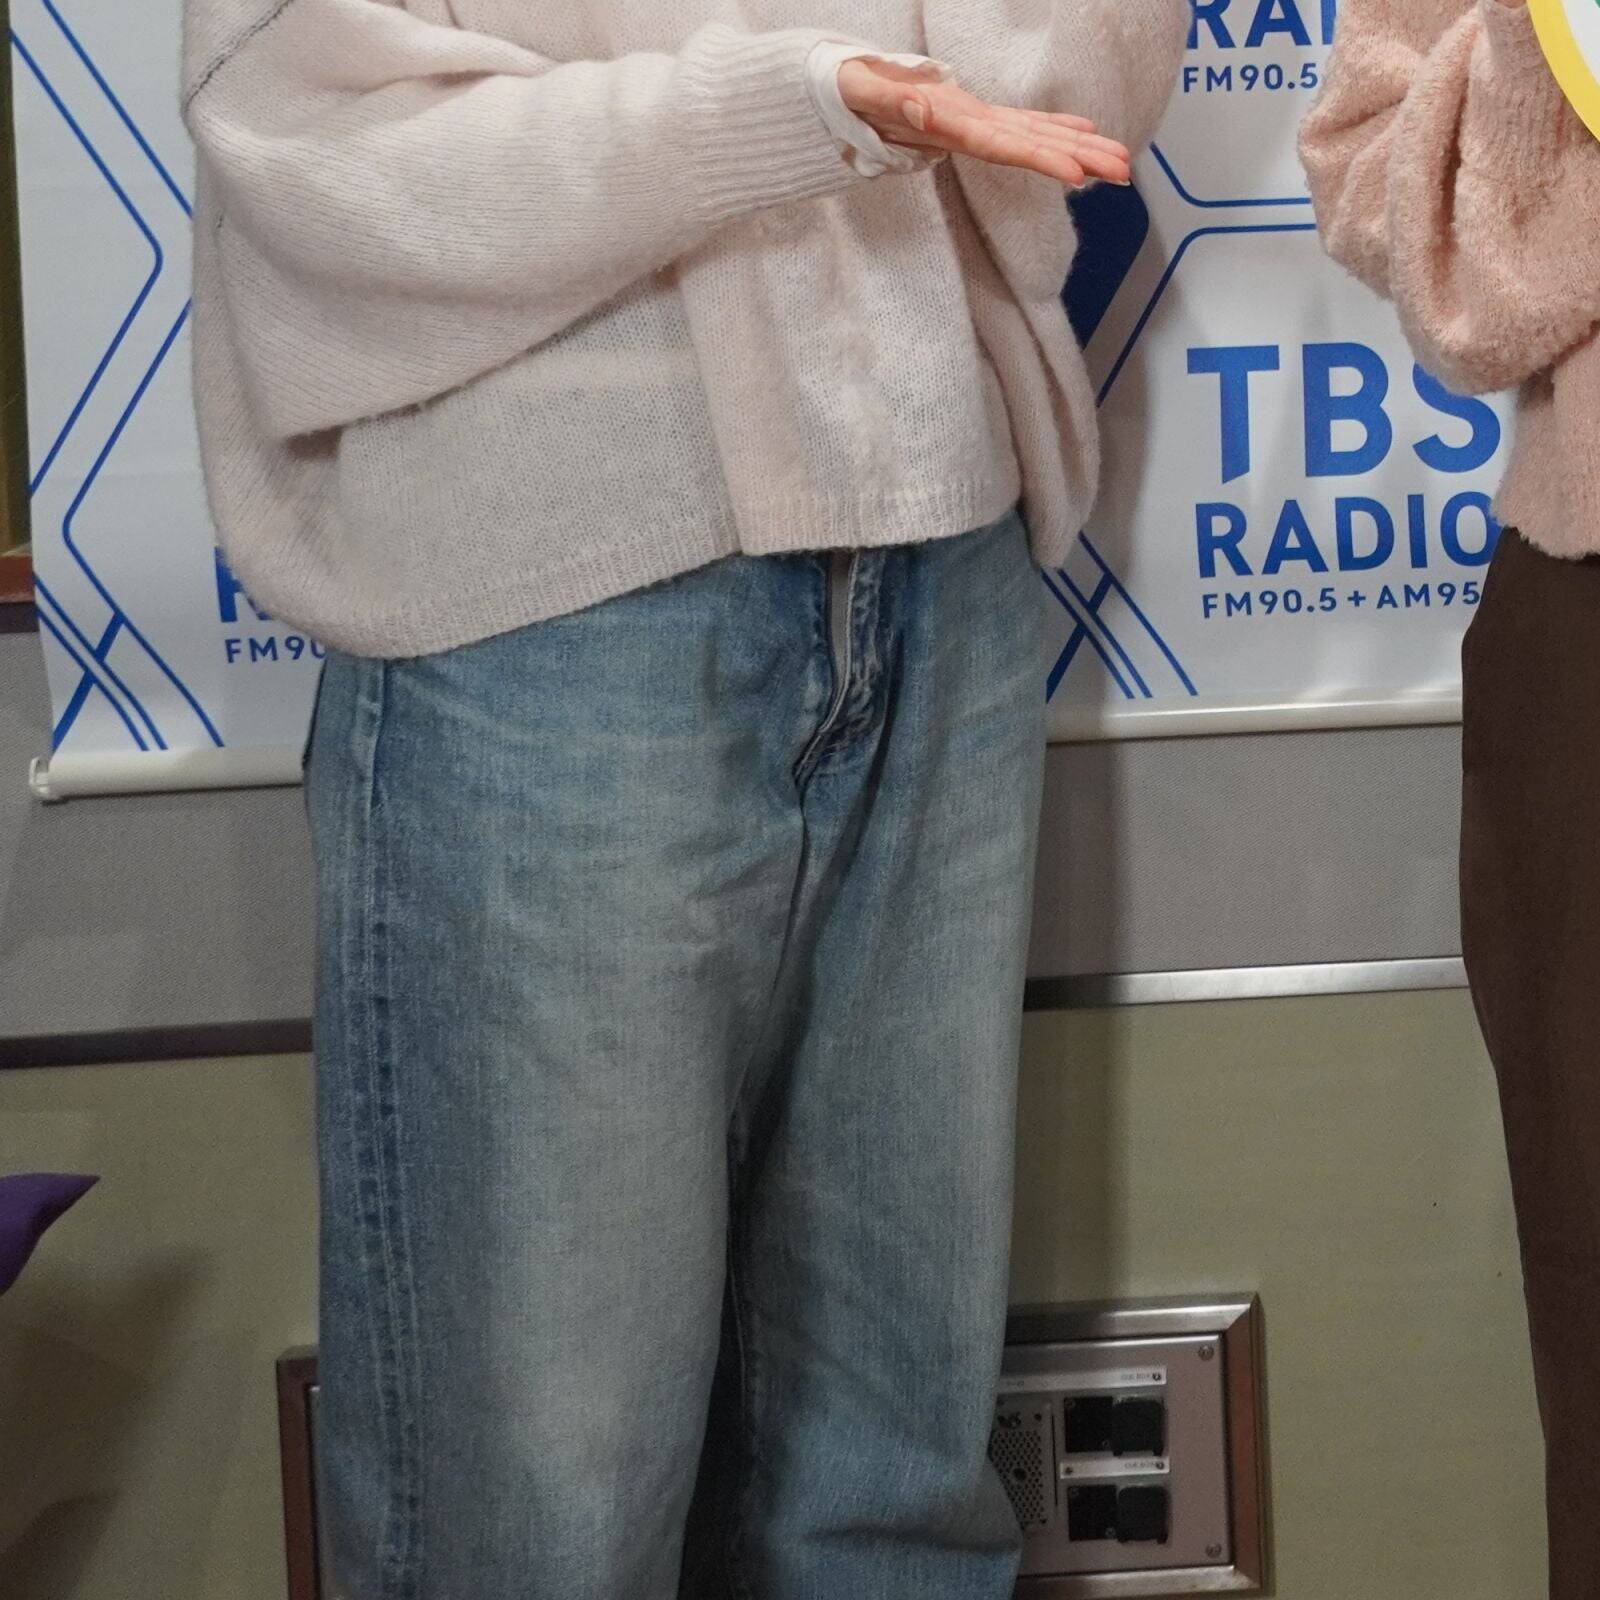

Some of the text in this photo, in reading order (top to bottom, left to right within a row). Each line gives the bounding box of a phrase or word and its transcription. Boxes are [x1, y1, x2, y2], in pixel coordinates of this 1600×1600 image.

[1187, 342, 1501, 485] TBS
[1195, 491, 1500, 579] RADIO
[1202, 580, 1482, 619] FM90.5+AM95
